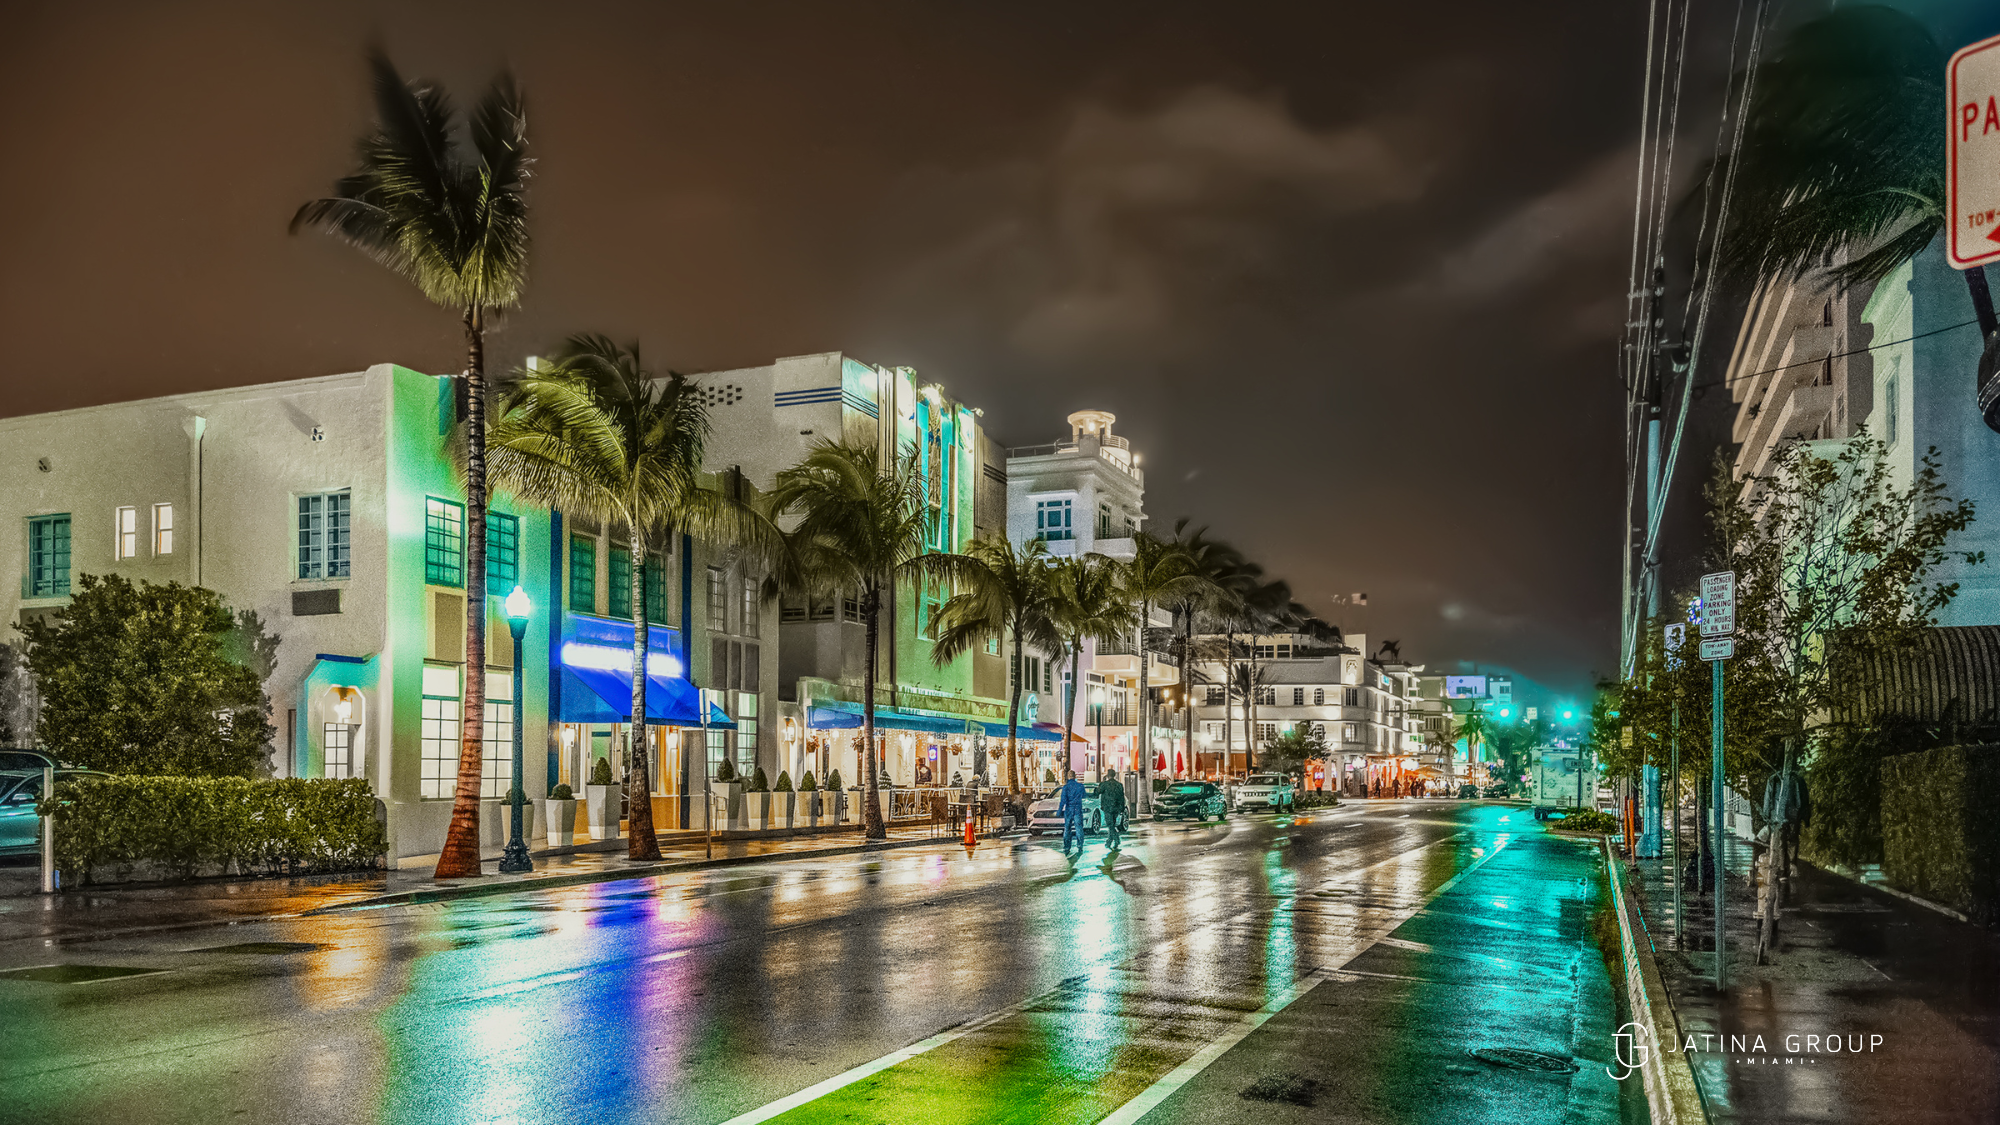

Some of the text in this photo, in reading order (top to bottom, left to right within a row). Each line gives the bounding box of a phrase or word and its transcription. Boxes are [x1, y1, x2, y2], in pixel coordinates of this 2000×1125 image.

[1703, 575, 1731, 586] PASSENGER
[1706, 584, 1728, 593] LOADING
[1710, 592, 1725, 601] ZONE
[1703, 600, 1731, 609] PARKING
[1709, 608, 1725, 616] ONLY
[1714, 615, 1731, 623] HOURS
